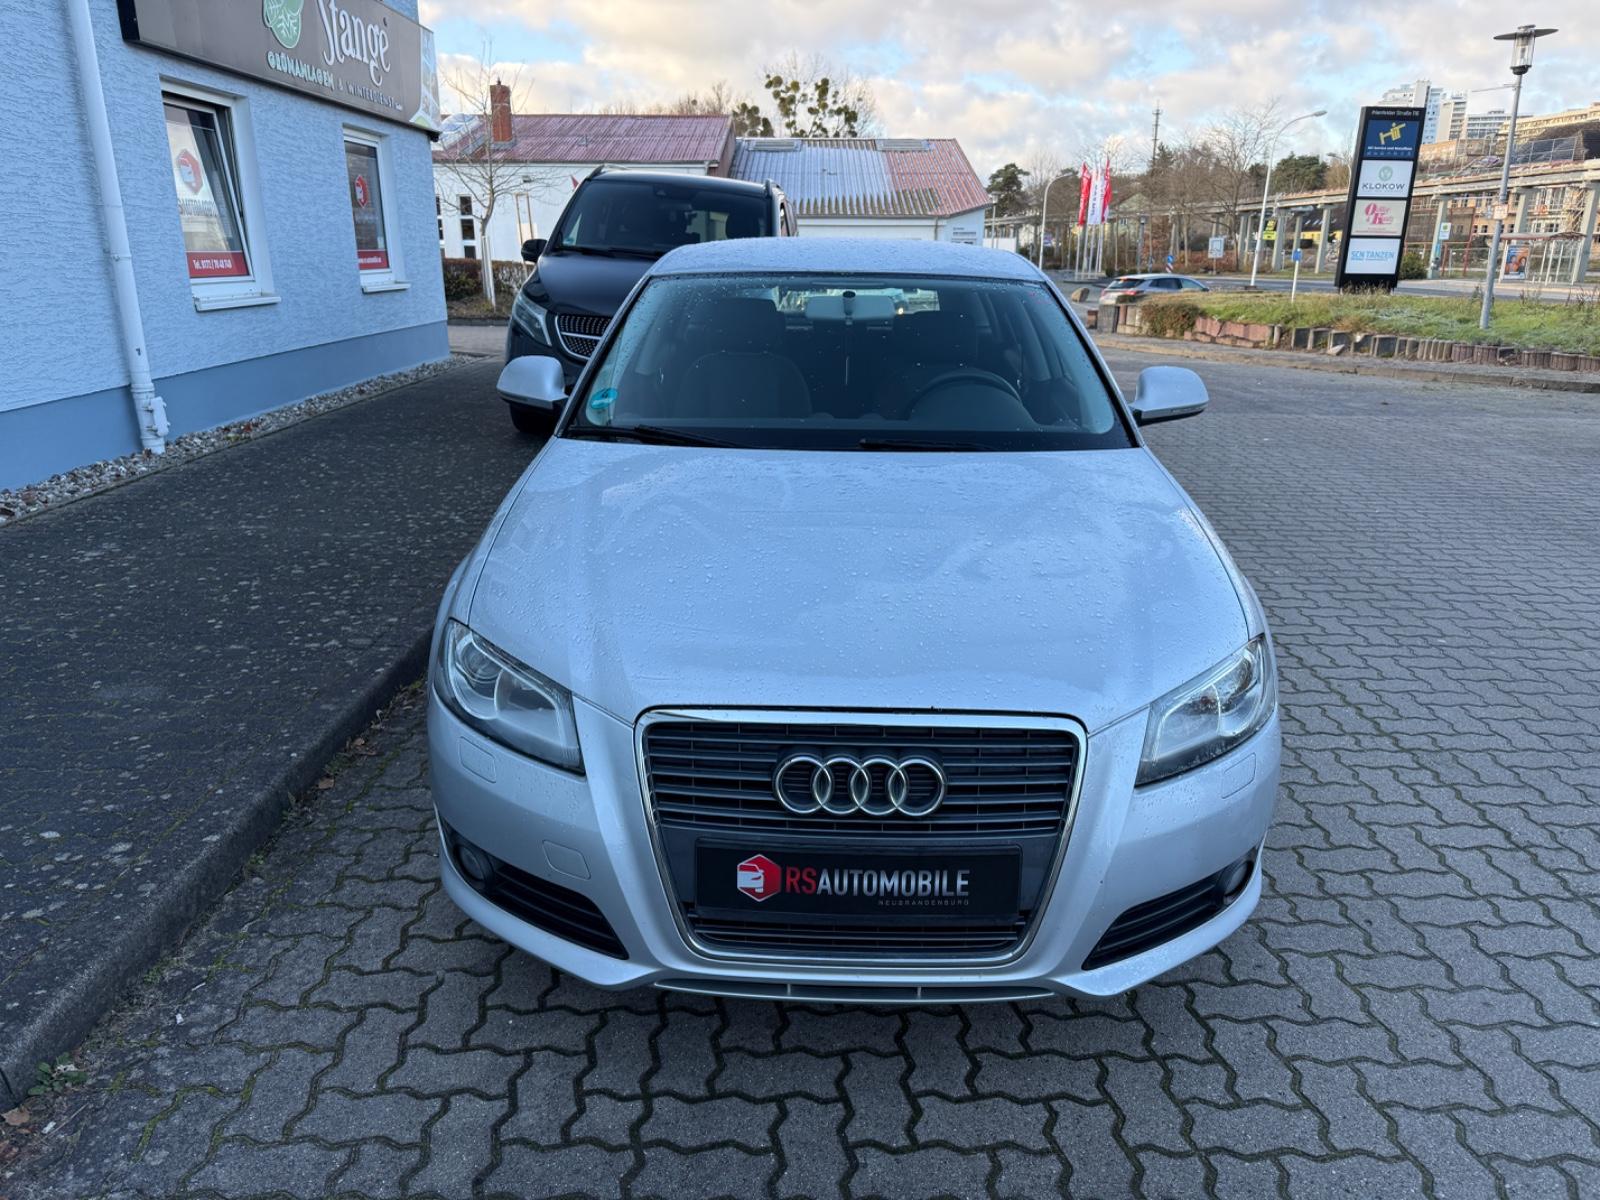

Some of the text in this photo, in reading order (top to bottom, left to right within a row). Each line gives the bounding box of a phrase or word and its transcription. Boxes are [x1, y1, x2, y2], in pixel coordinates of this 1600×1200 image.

[267, 51, 335, 91] GRÜNANLAGEN
[1366, 250, 1394, 258] TANZEN
[785, 867, 970, 896] RSAUTOMOBILE
